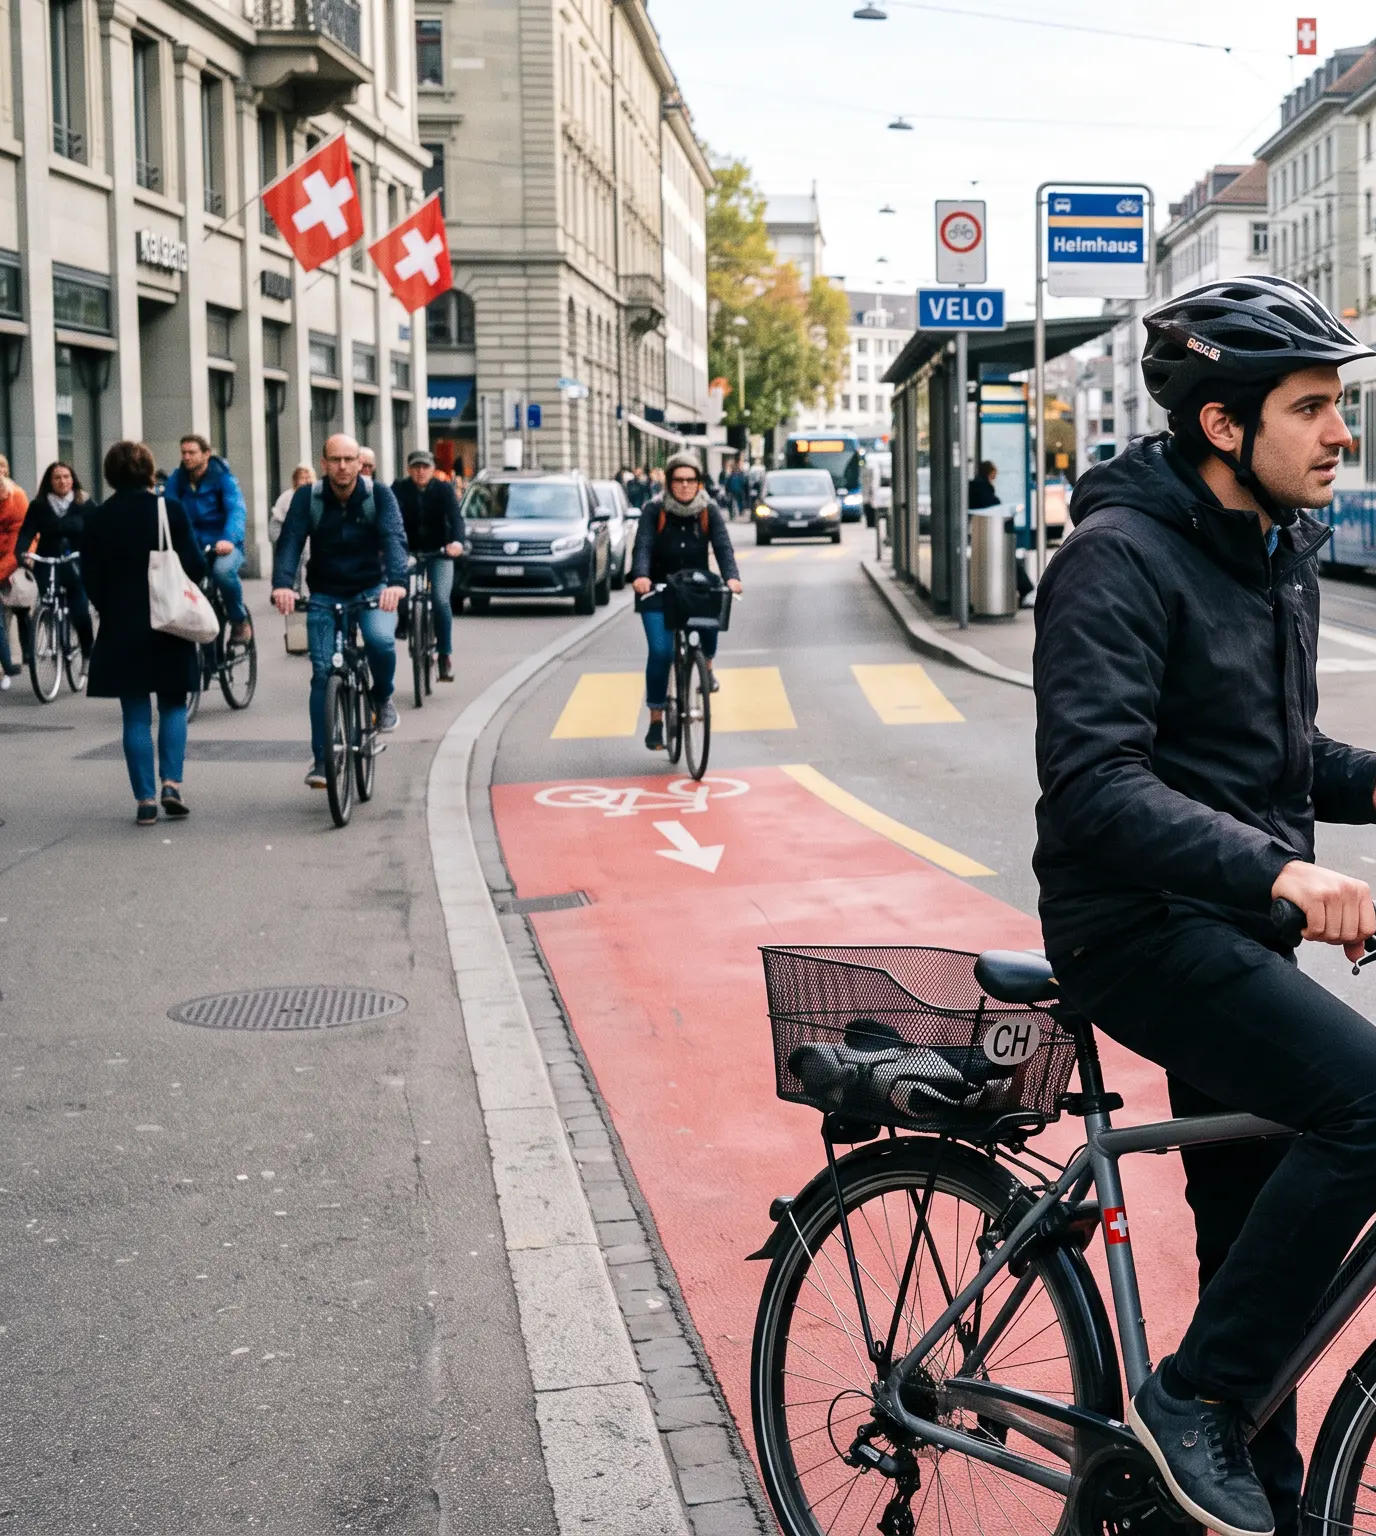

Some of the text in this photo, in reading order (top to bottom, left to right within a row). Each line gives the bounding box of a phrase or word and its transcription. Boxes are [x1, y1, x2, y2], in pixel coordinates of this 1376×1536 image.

[1054, 236, 1138, 253] Helmhaus
[928, 297, 994, 321] VELO
[993, 1024, 1031, 1058] CH
